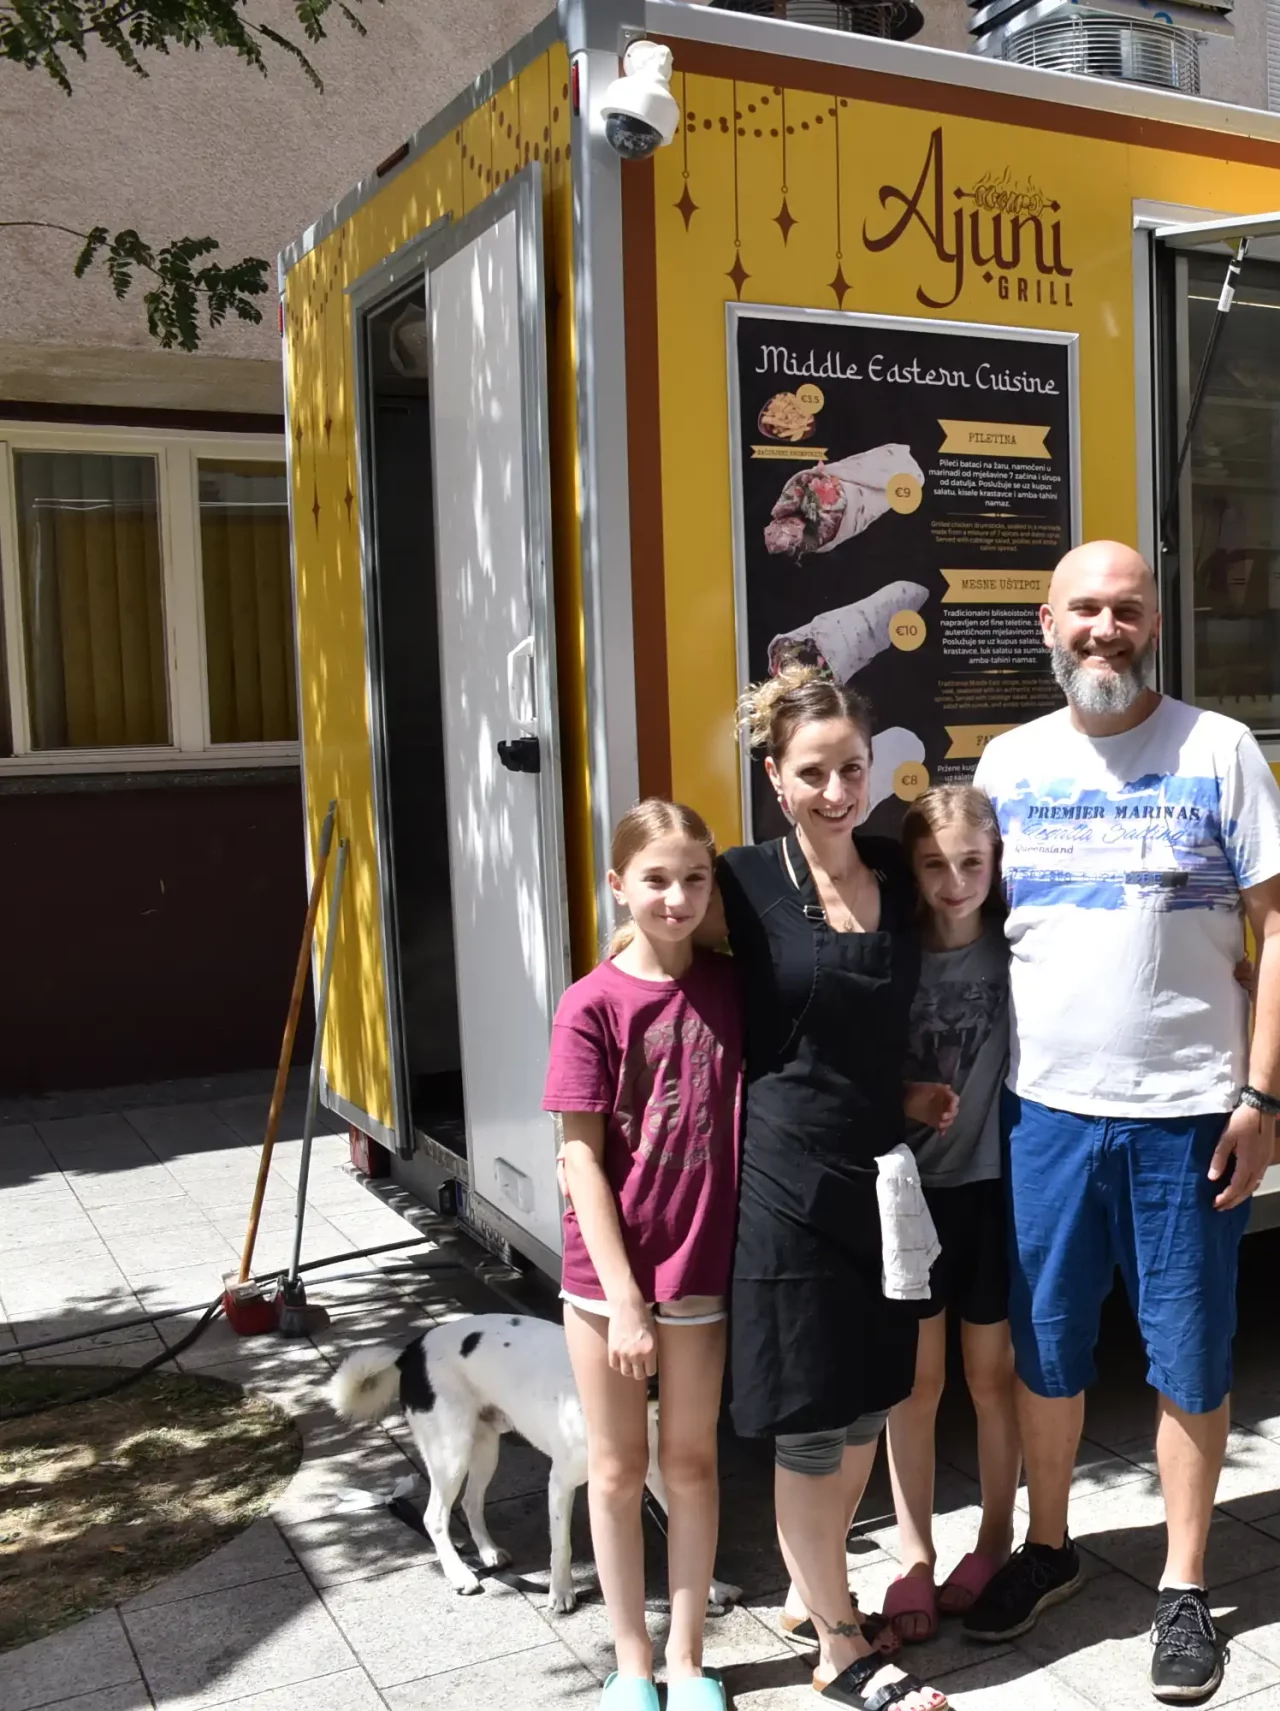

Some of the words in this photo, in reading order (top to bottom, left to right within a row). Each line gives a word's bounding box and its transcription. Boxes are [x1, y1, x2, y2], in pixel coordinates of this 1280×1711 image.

[863, 126, 1073, 308] Ajuni
[998, 274, 1073, 306] GRILL
[755, 345, 863, 380] Middle
[868, 354, 970, 388] Eastern
[976, 362, 1059, 395] Cuisine
[968, 432, 1017, 445] PILETINA
[962, 469, 971, 477] od
[895, 487, 911, 498] €9
[962, 579, 997, 590] MESNE
[1000, 578, 1041, 591] UŠTIPCI
[943, 609, 990, 617] Tradicionalni
[896, 625, 918, 636] €10
[937, 765, 961, 773] Pržene
[901, 775, 918, 786] €8
[1027, 805, 1105, 821] PREMIER
[1114, 805, 1201, 821] MARINAS
